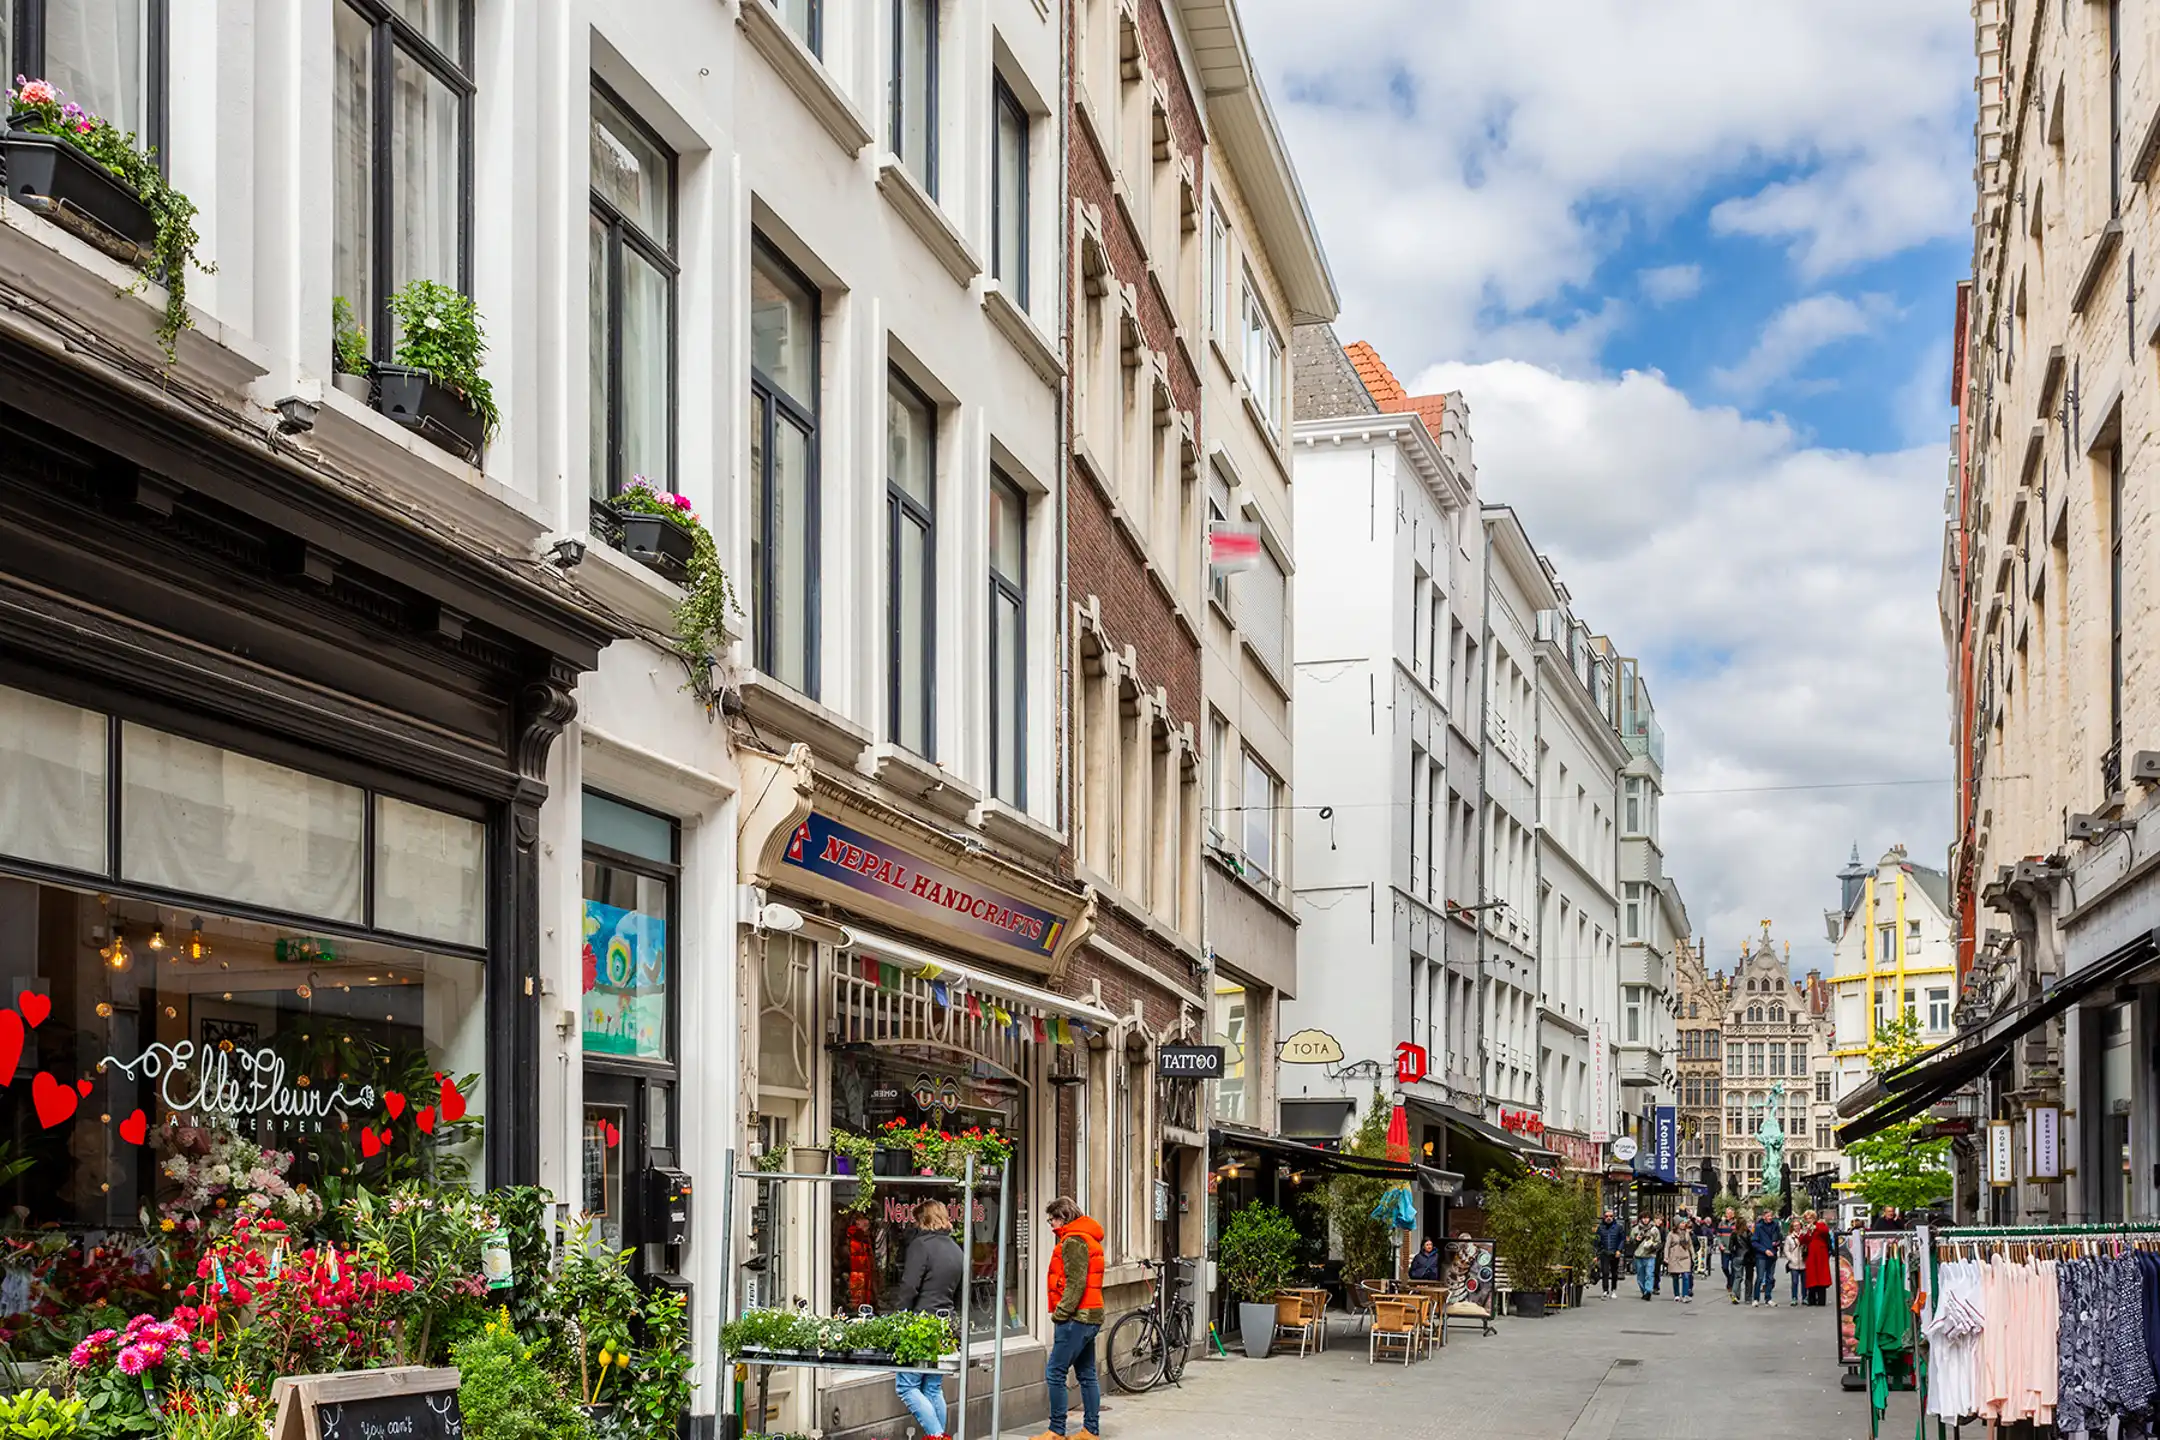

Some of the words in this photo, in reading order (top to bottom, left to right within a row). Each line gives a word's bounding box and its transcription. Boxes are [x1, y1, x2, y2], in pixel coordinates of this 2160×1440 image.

[820, 836, 908, 891] NEPAL
[909, 873, 1044, 941] HANDCRAFTS
[1293, 1043, 1330, 1055] TOTA
[1162, 1054, 1217, 1069] TATTOO
[170, 1115, 322, 1133] ANTWERPEN
[1660, 1118, 1671, 1170] Leonidas
[387, 1416, 414, 1434] can't
